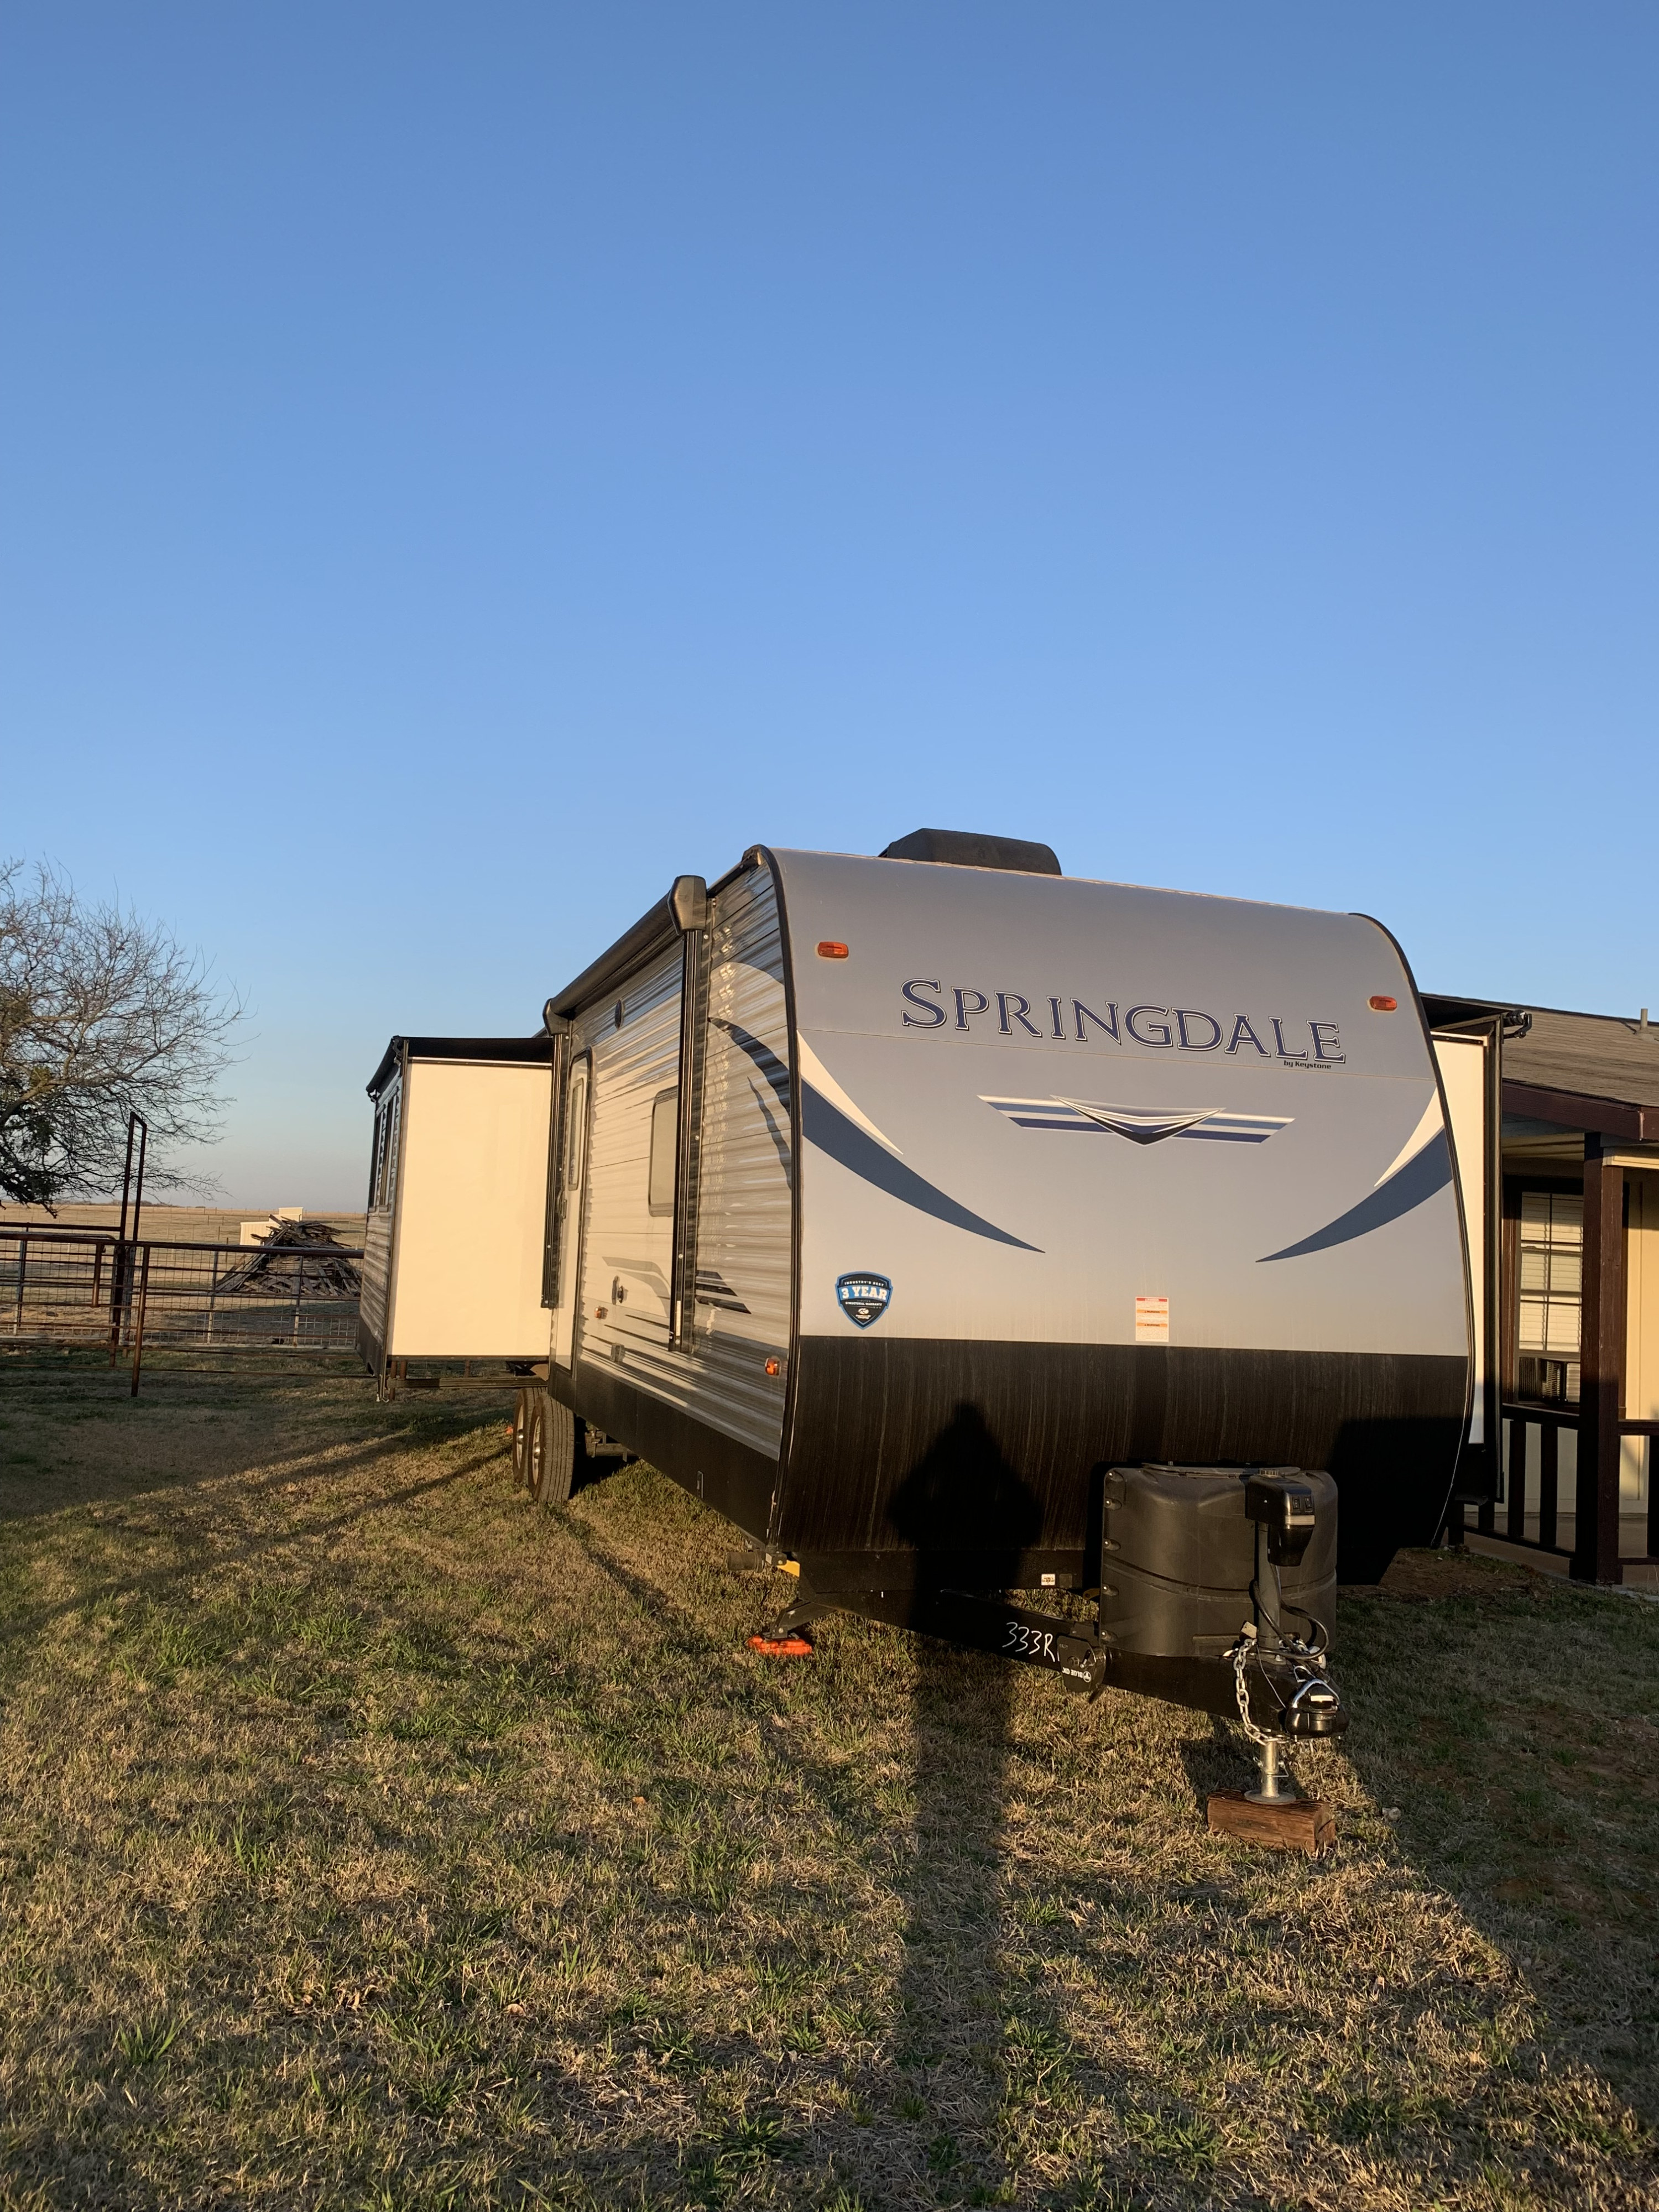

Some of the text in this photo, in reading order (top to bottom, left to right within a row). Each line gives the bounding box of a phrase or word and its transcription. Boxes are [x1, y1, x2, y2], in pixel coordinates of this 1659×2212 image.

[901, 978, 1346, 1064] SPRINGDALE
[842, 1286, 887, 1300] 3 YEAR
[1001, 1621, 1056, 1662] 333R
[1070, 1669, 1084, 1678] BLUE
